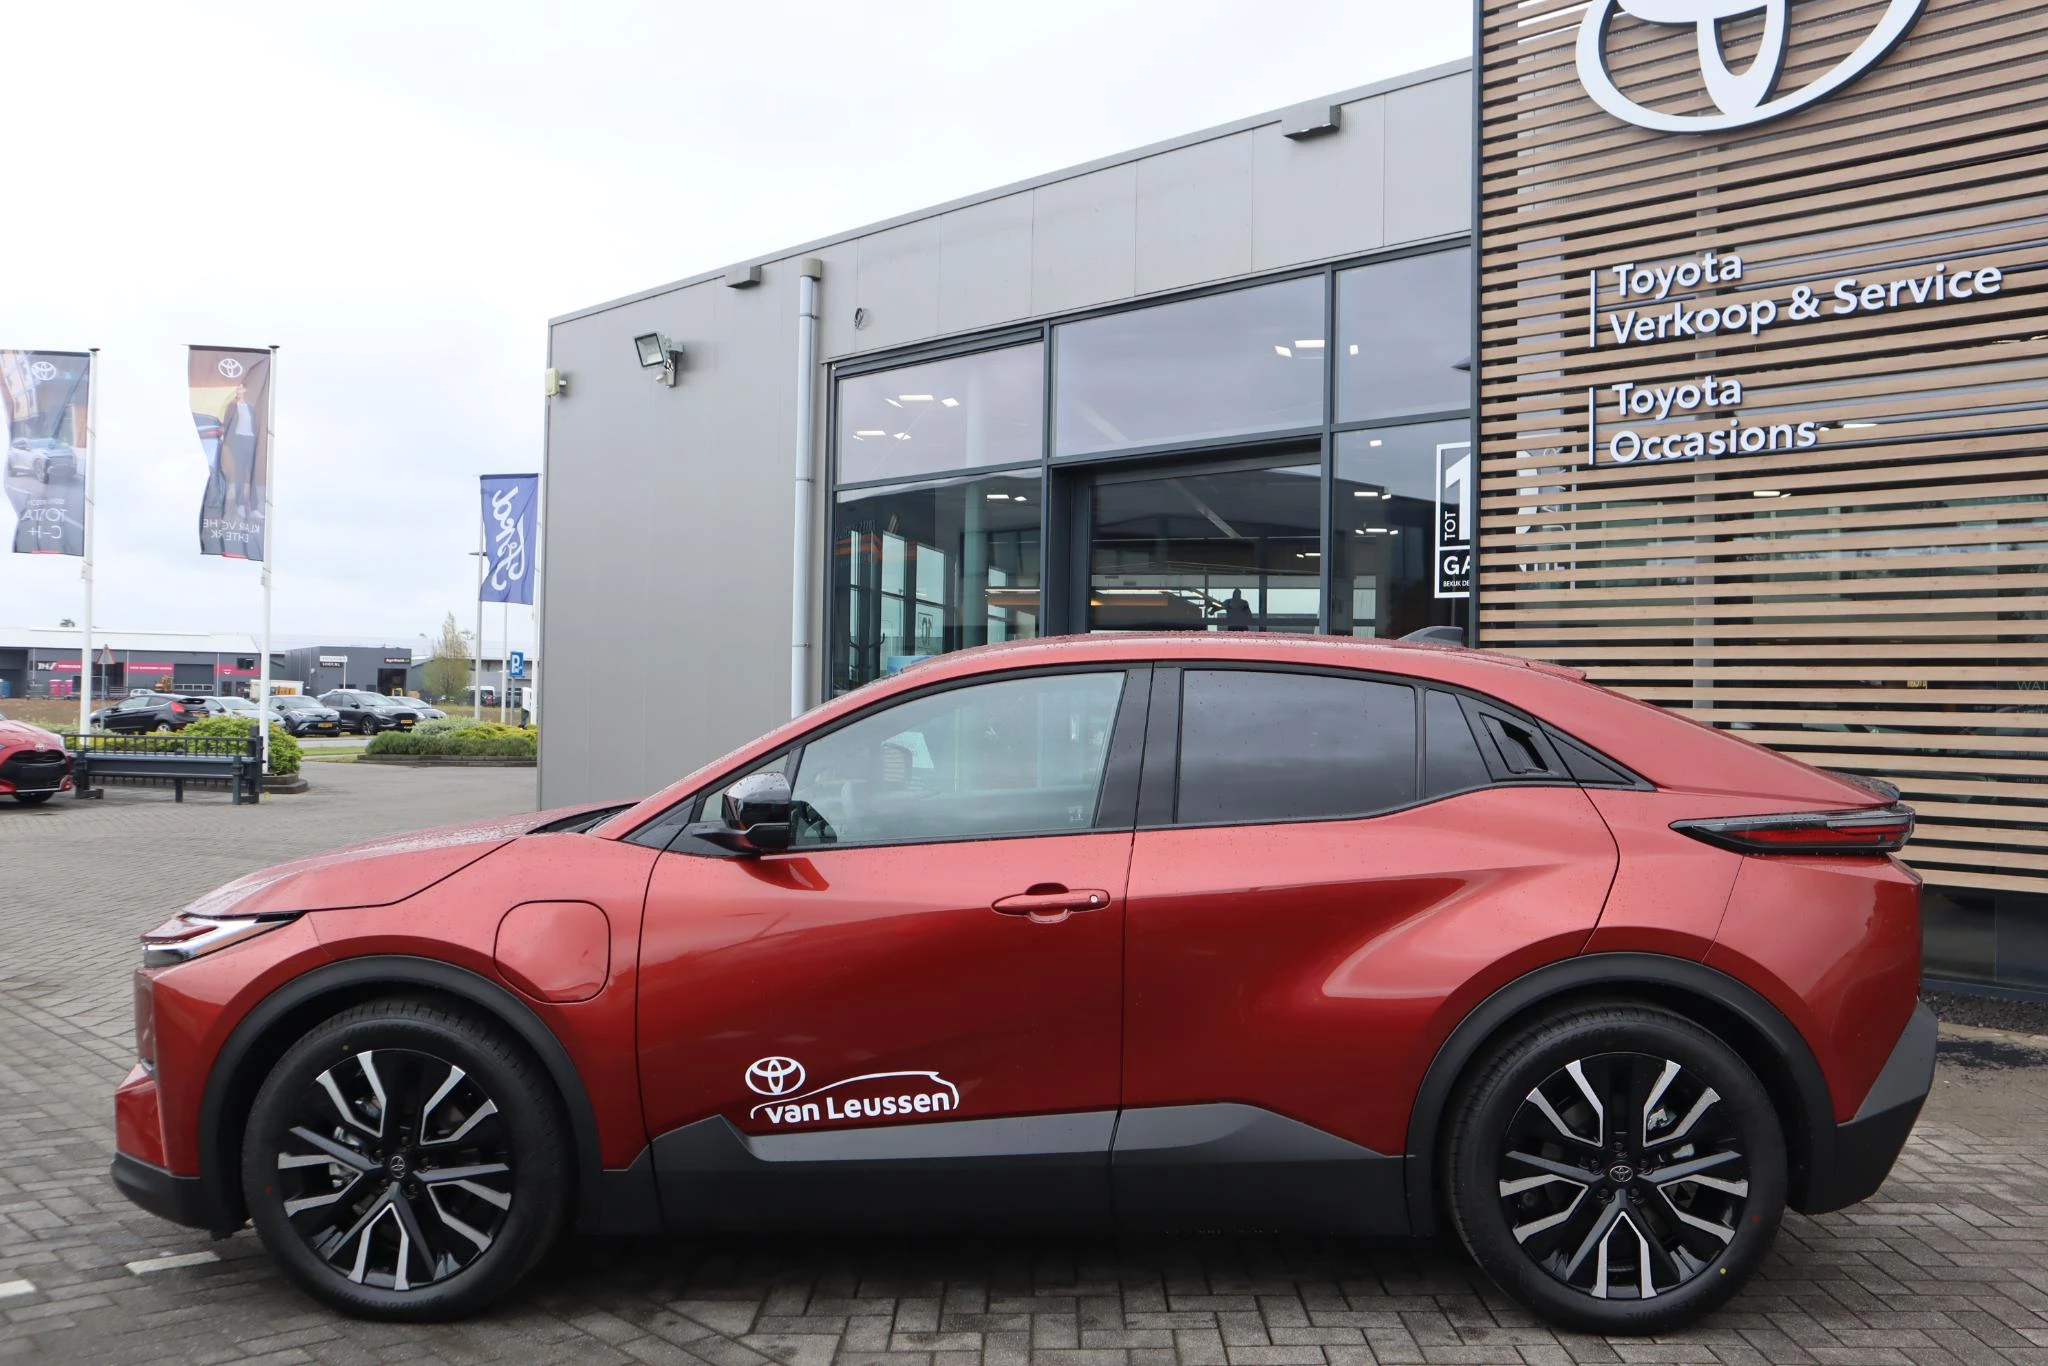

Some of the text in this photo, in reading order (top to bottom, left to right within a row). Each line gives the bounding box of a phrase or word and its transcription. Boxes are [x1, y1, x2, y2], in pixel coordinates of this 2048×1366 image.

[1612, 252, 1744, 301] Toyota
[1609, 263, 2003, 343] Verkoop & Service
[1612, 375, 1743, 421] Toyota
[1609, 421, 1818, 463] Occasions
[1444, 511, 1457, 541] TOT
[764, 1092, 950, 1124] van Leussen
